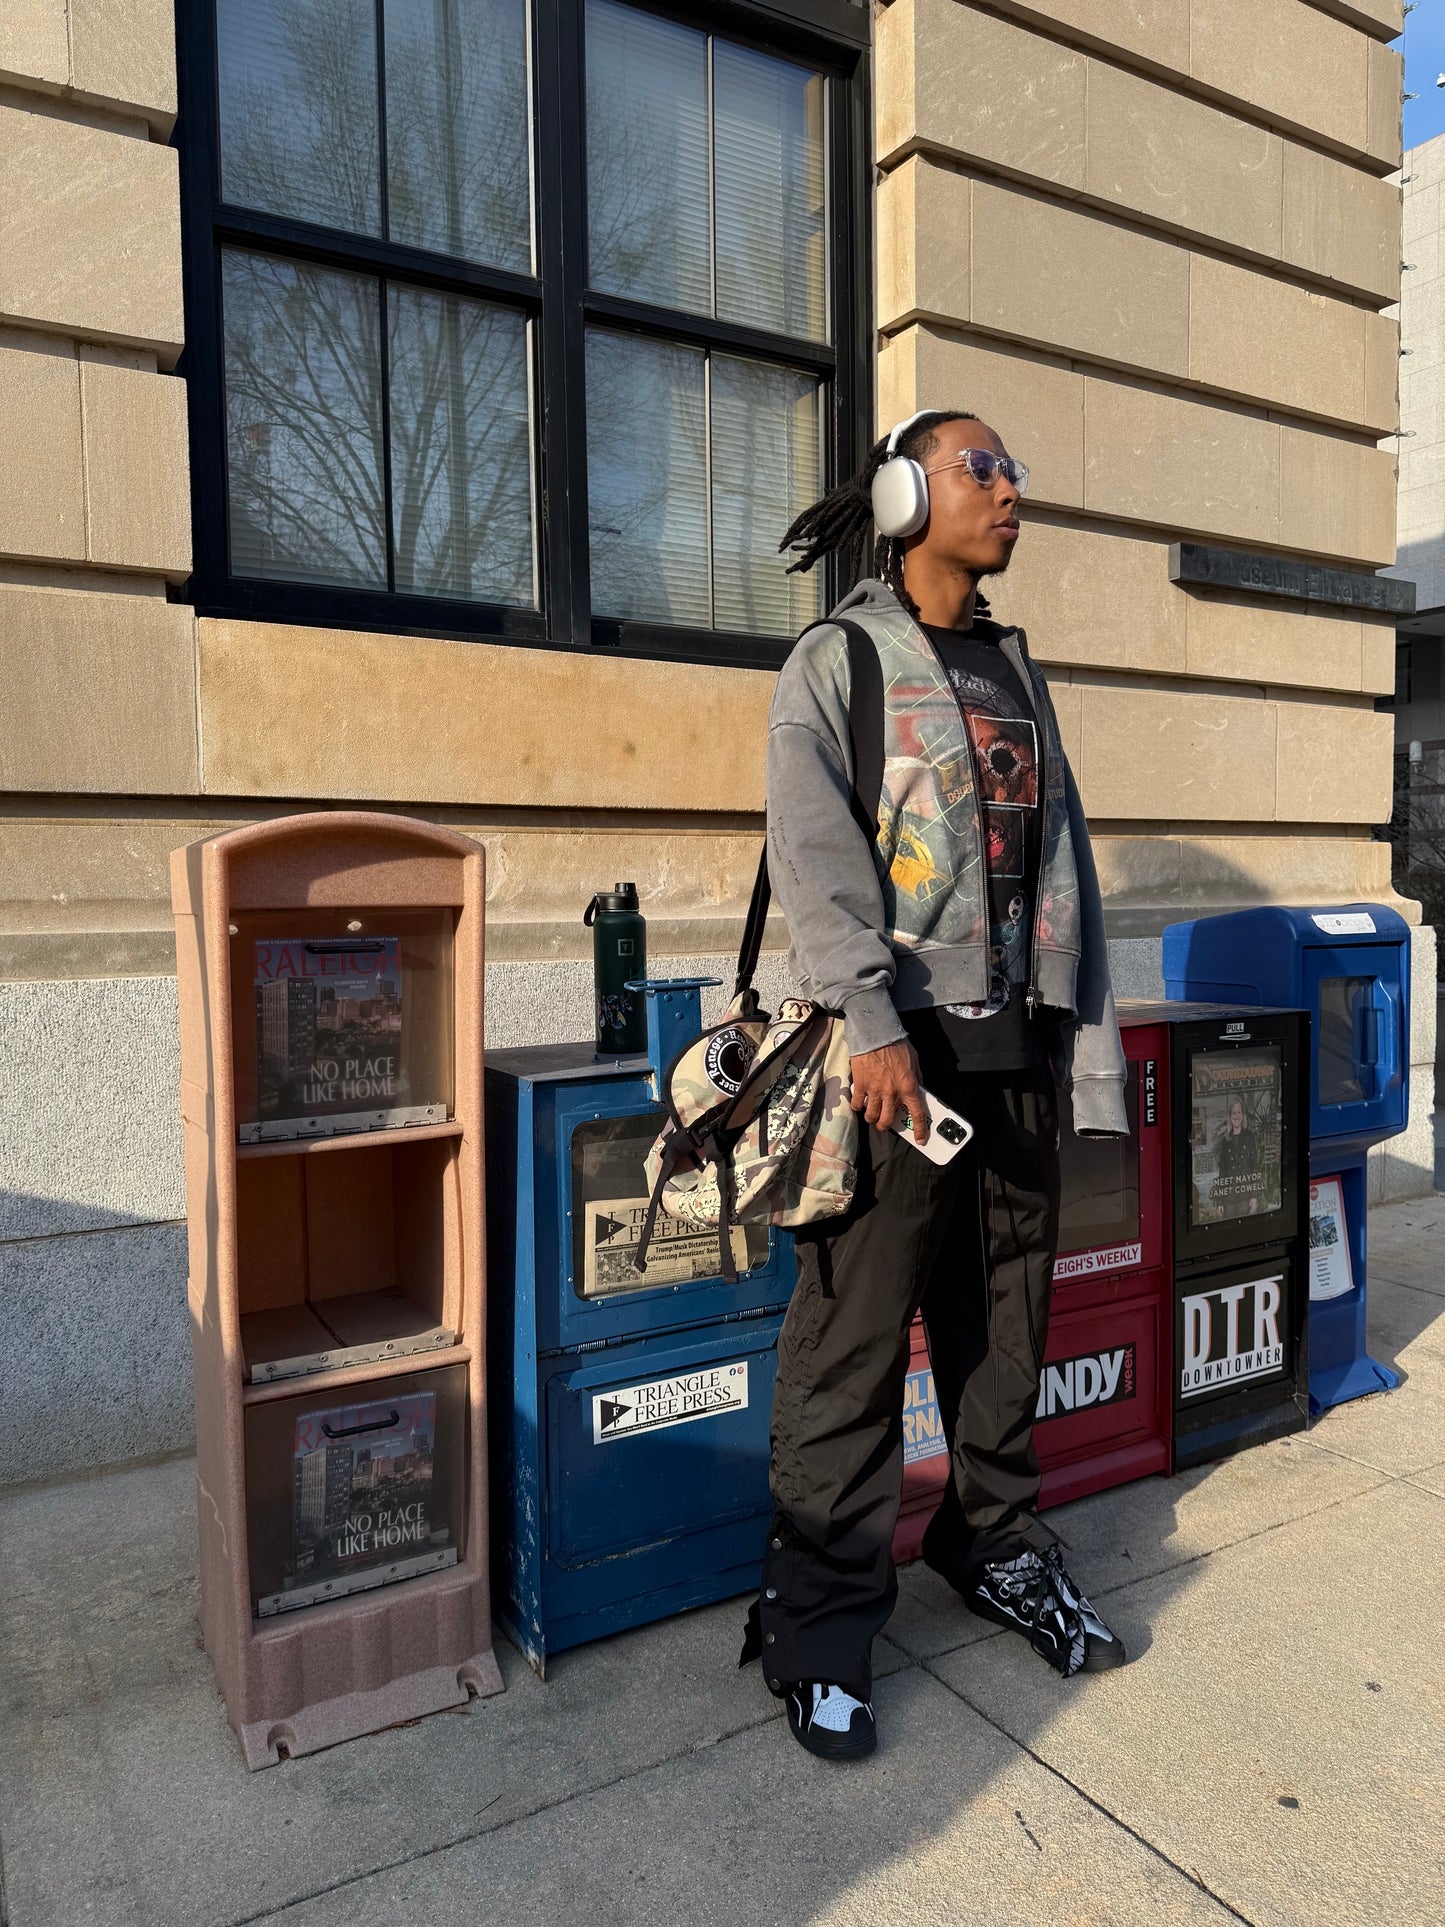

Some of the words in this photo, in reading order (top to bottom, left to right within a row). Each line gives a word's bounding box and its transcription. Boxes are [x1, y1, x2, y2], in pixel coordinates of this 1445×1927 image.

[254, 942, 401, 979] RALEIGH
[1227, 1023, 1243, 1033] PULL
[311, 1061, 340, 1082] NO
[346, 1057, 394, 1079] PLACE
[303, 1081, 338, 1104] LIKE
[342, 1076, 396, 1100] HOME
[1146, 1061, 1155, 1123] FREE
[1209, 1186, 1233, 1198] JANET
[1234, 1181, 1266, 1194] COWELL
[1213, 1176, 1234, 1187] MEET
[1236, 1172, 1263, 1184] MAYOR
[646, 1252, 678, 1263] Galvanizing
[655, 1243, 687, 1254] Trump/Musk
[688, 1239, 719, 1251] Dictatorship
[1096, 1247, 1139, 1267] WEEKLY
[1182, 1279, 1281, 1369] DTR
[1124, 1346, 1133, 1394] week
[1182, 1346, 1282, 1388] DOWNTOWNER
[634, 1371, 721, 1404] TRIANGLE
[635, 1398, 678, 1422] FREE
[683, 1386, 731, 1410] PRESS
[294, 1398, 435, 1453] RALEIGH
[904, 1446, 917, 1455] EWS,
[344, 1514, 372, 1536] NO
[378, 1502, 425, 1529] PLACE
[337, 1531, 370, 1558] LIKE
[374, 1520, 425, 1549] HOME
